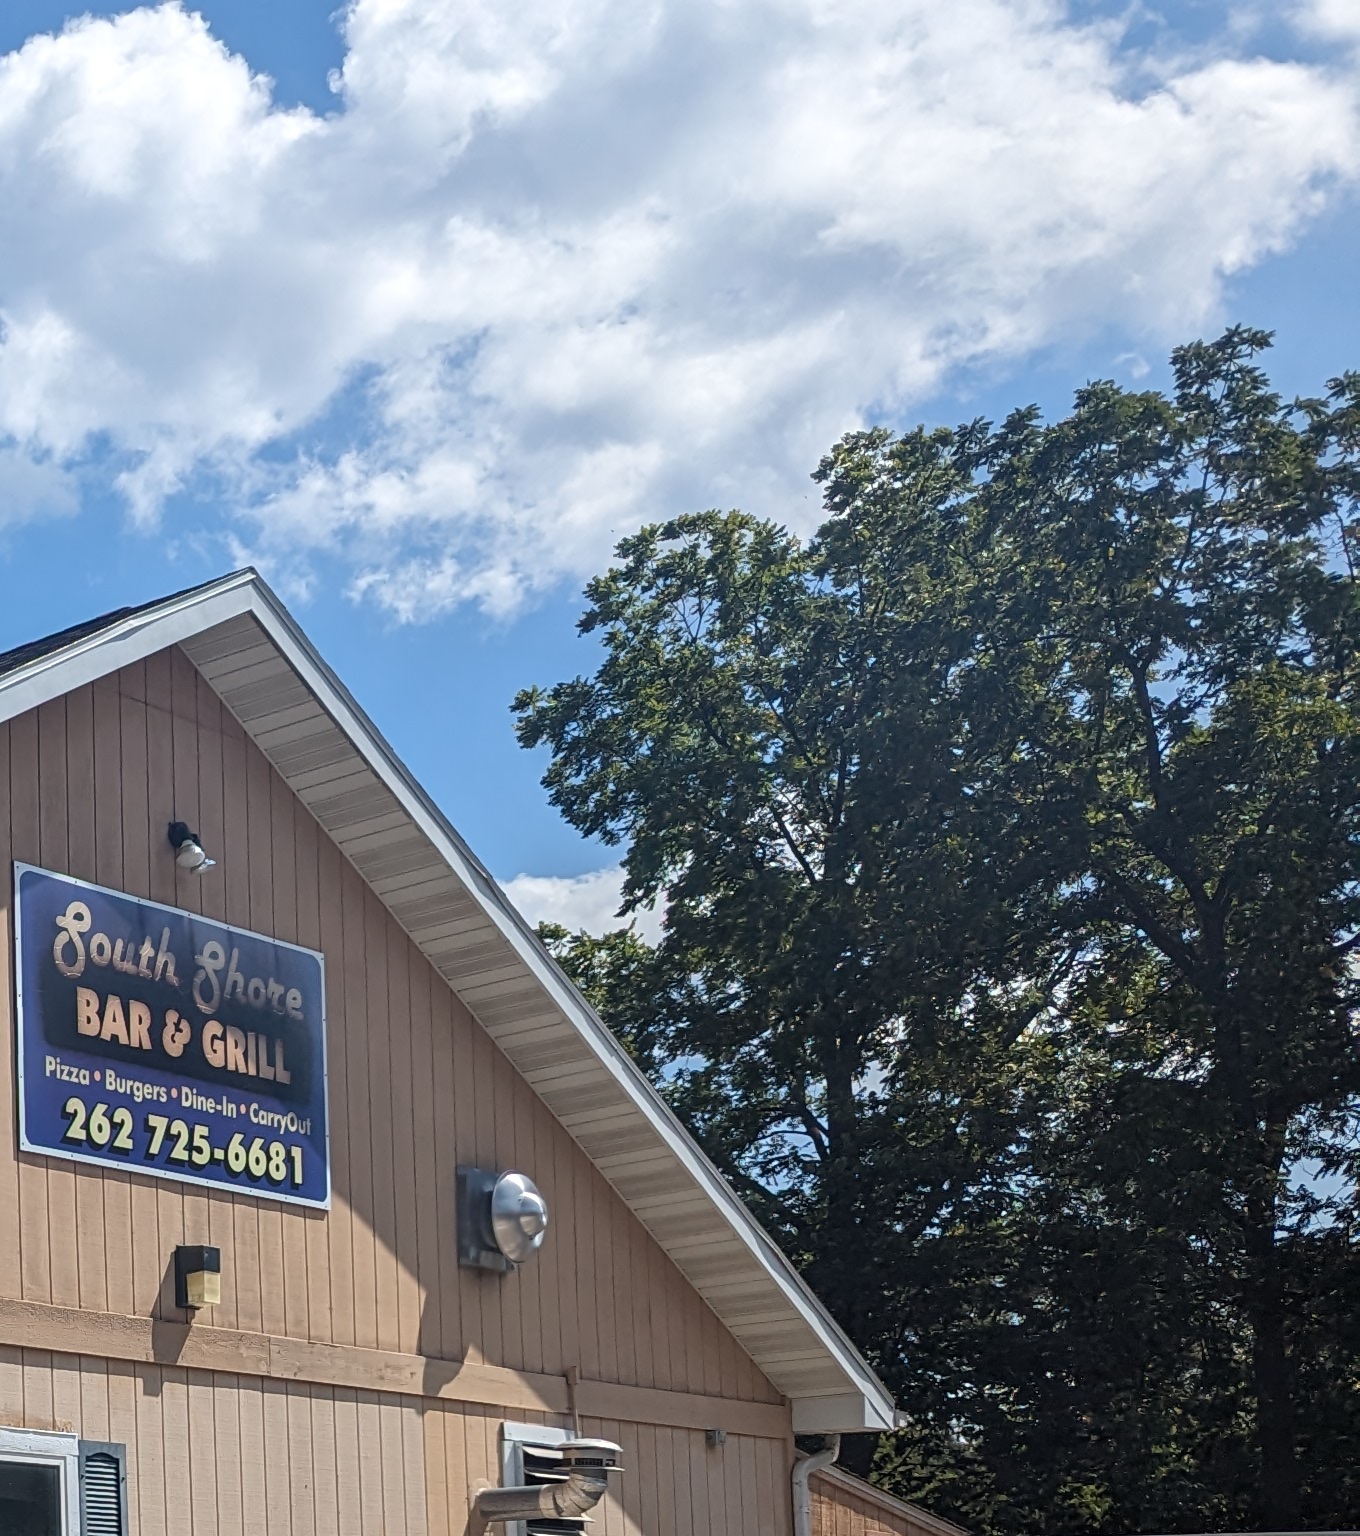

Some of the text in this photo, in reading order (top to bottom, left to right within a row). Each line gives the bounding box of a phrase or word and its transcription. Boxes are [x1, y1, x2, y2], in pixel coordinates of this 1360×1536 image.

[53, 901, 305, 1020] South Shore
[76, 986, 292, 1085] BAR & GRILL
[45, 1055, 90, 1086] Pizza
[105, 1069, 167, 1103] Burgers
[181, 1086, 236, 1119] Dine-In
[65, 1098, 303, 1184] 262 725-6681
